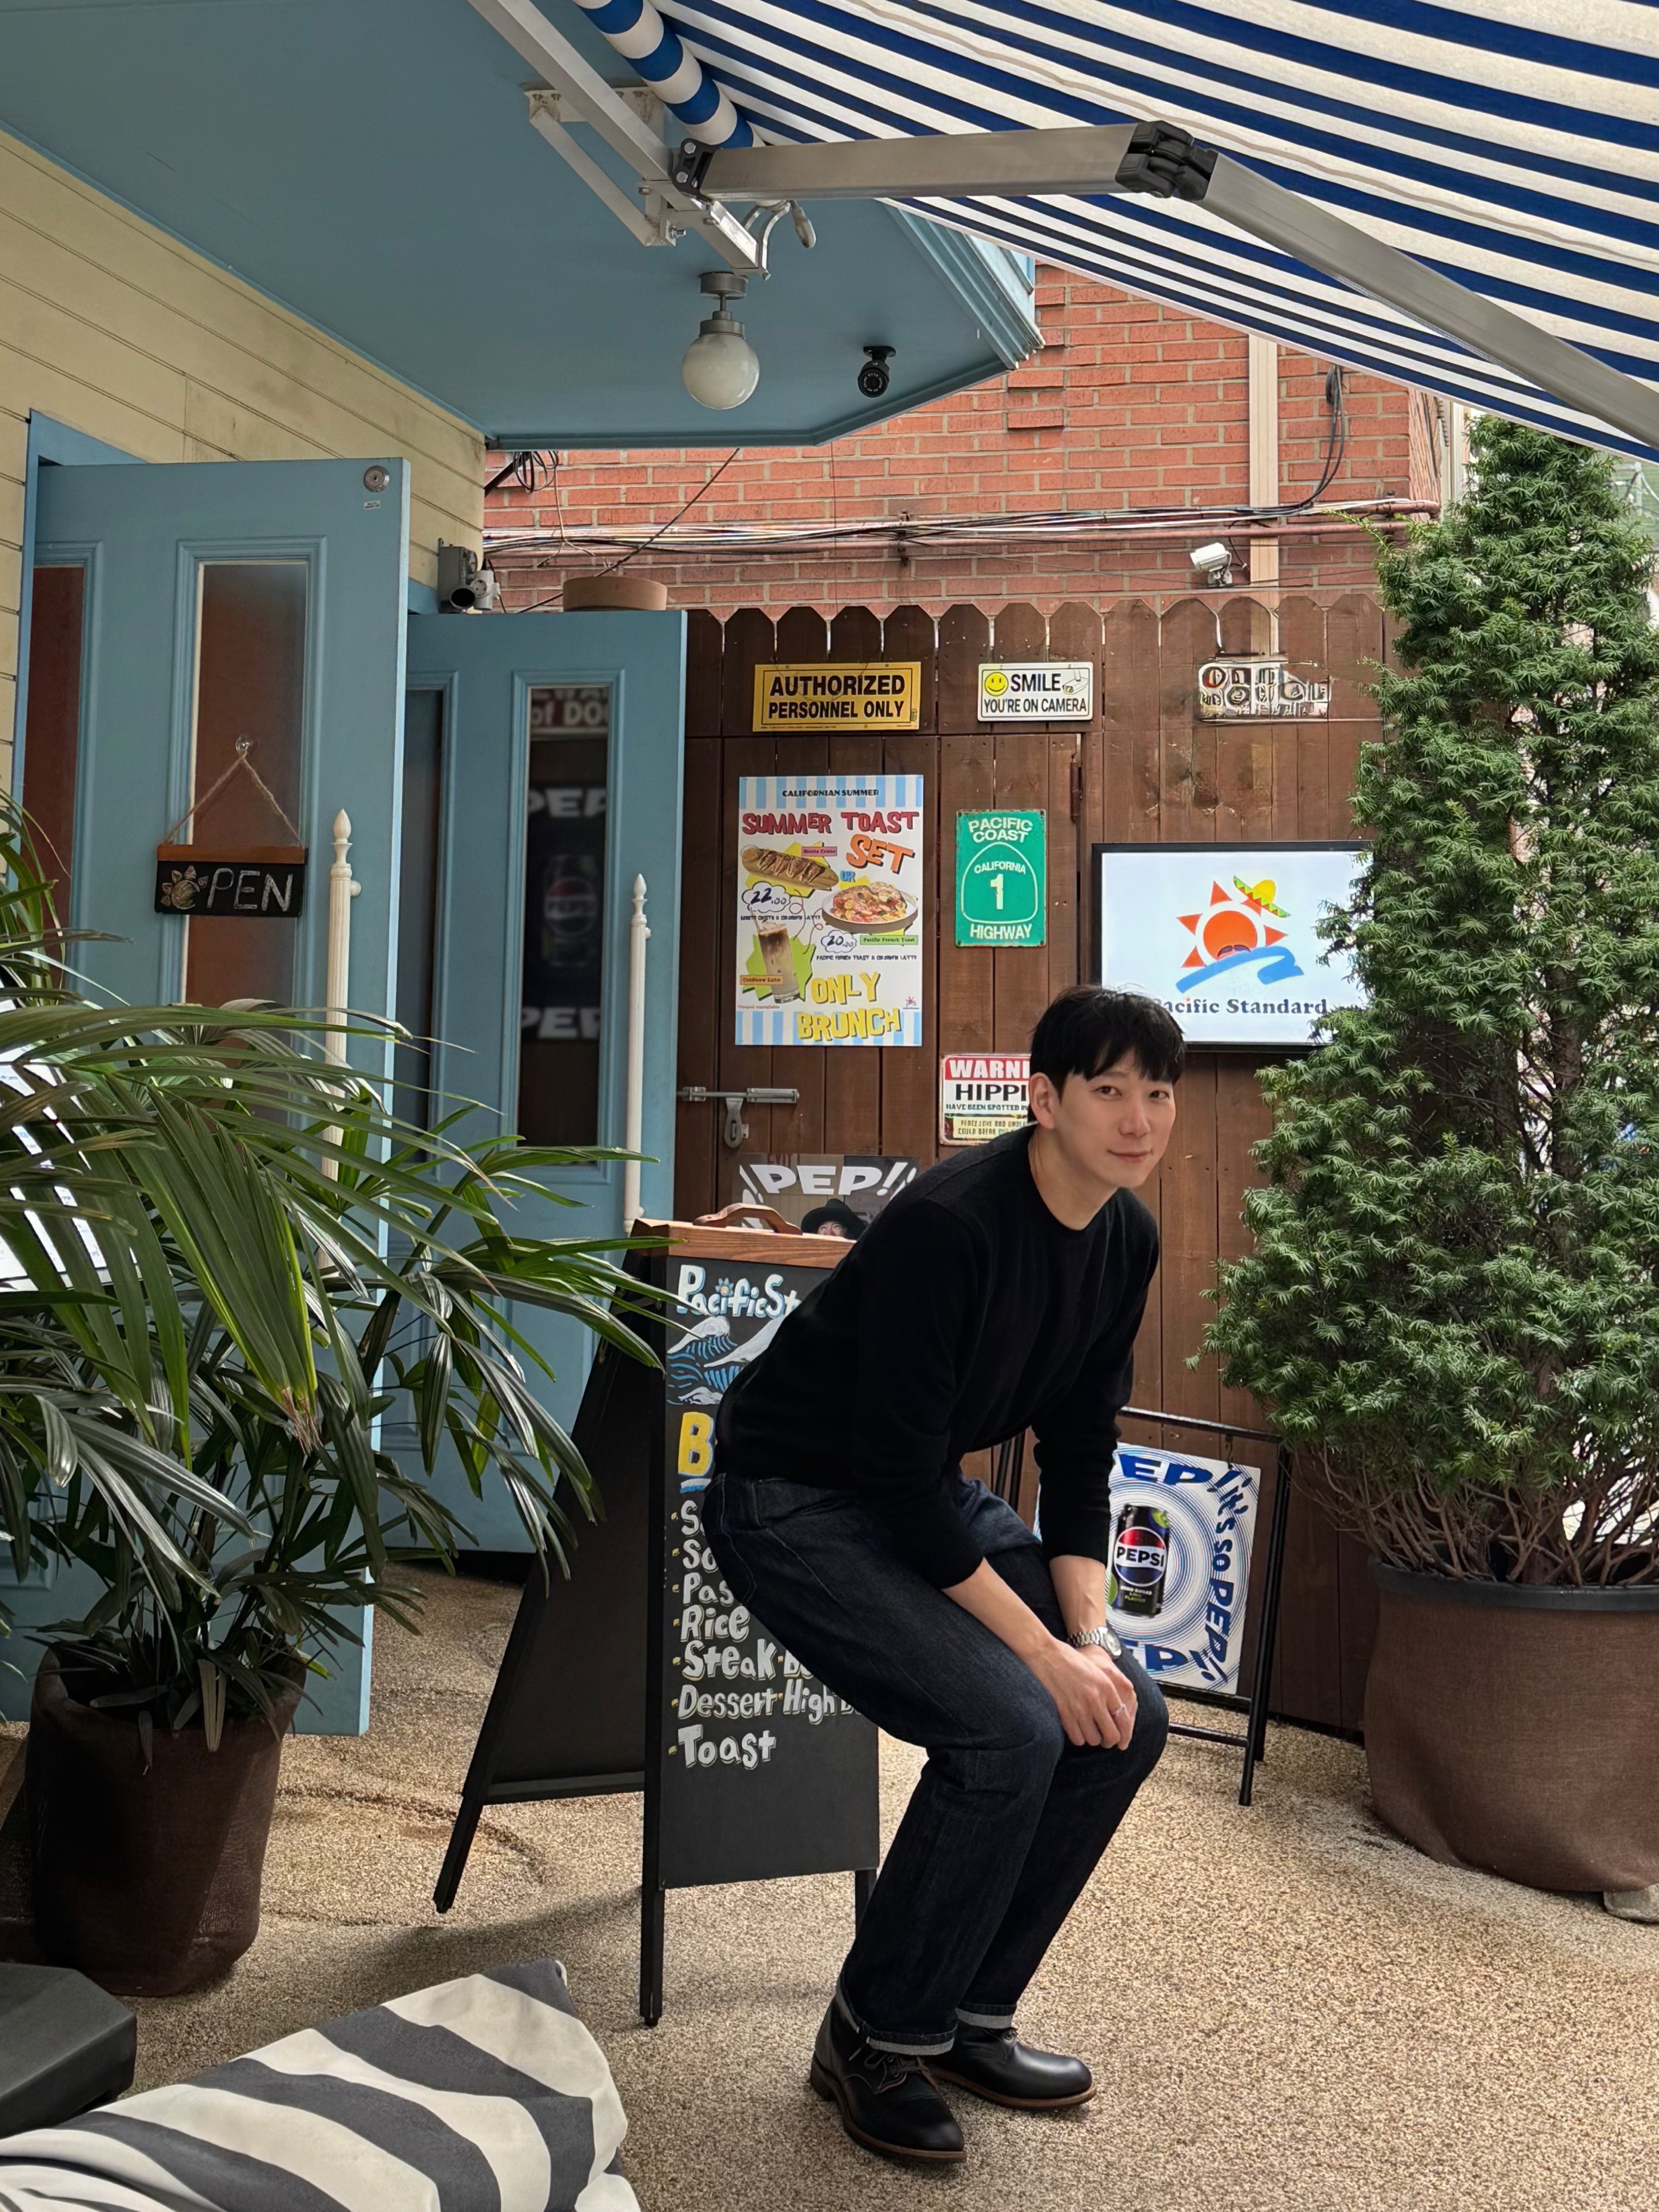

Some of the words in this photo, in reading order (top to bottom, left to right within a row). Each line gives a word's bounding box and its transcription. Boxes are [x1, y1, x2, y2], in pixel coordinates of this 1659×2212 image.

[770, 675, 905, 696] AUTHORIZED
[1011, 674, 1061, 692] SMILE
[563, 700, 608, 726] DO
[768, 702, 858, 719] PERSONNEL
[864, 700, 904, 718] ONLY
[984, 699, 1021, 713] YOU'RE
[1023, 699, 1039, 712] ON
[1041, 698, 1087, 712] CAMERA
[743, 812, 832, 835] SUMMER
[841, 811, 919, 833] TOAST
[968, 817, 1033, 833] PACIFIC
[972, 829, 1029, 843] COAST
[846, 834, 915, 875] SET
[840, 870, 856, 883] OR
[974, 861, 1026, 875] CALIFORNIA
[750, 887, 787, 905] 22.00
[990, 873, 1004, 910] 1
[827, 935, 853, 947] 20.00
[970, 923, 1032, 940] HIGHWAY
[811, 972, 880, 1004] ONLY
[1227, 999, 1327, 1014] Standard
[798, 1008, 902, 1041] BRUNCH
[956, 1084, 1027, 1101] HIPPI
[750, 1160, 908, 1196] PEP!
[681, 1500, 705, 1537] S
[1116, 1546, 1165, 1568] PEPSI
[680, 1604, 751, 1642] Rice
[682, 1638, 777, 1681] Steak
[678, 1684, 777, 1720] Dessert
[678, 1724, 777, 1770] Toast
